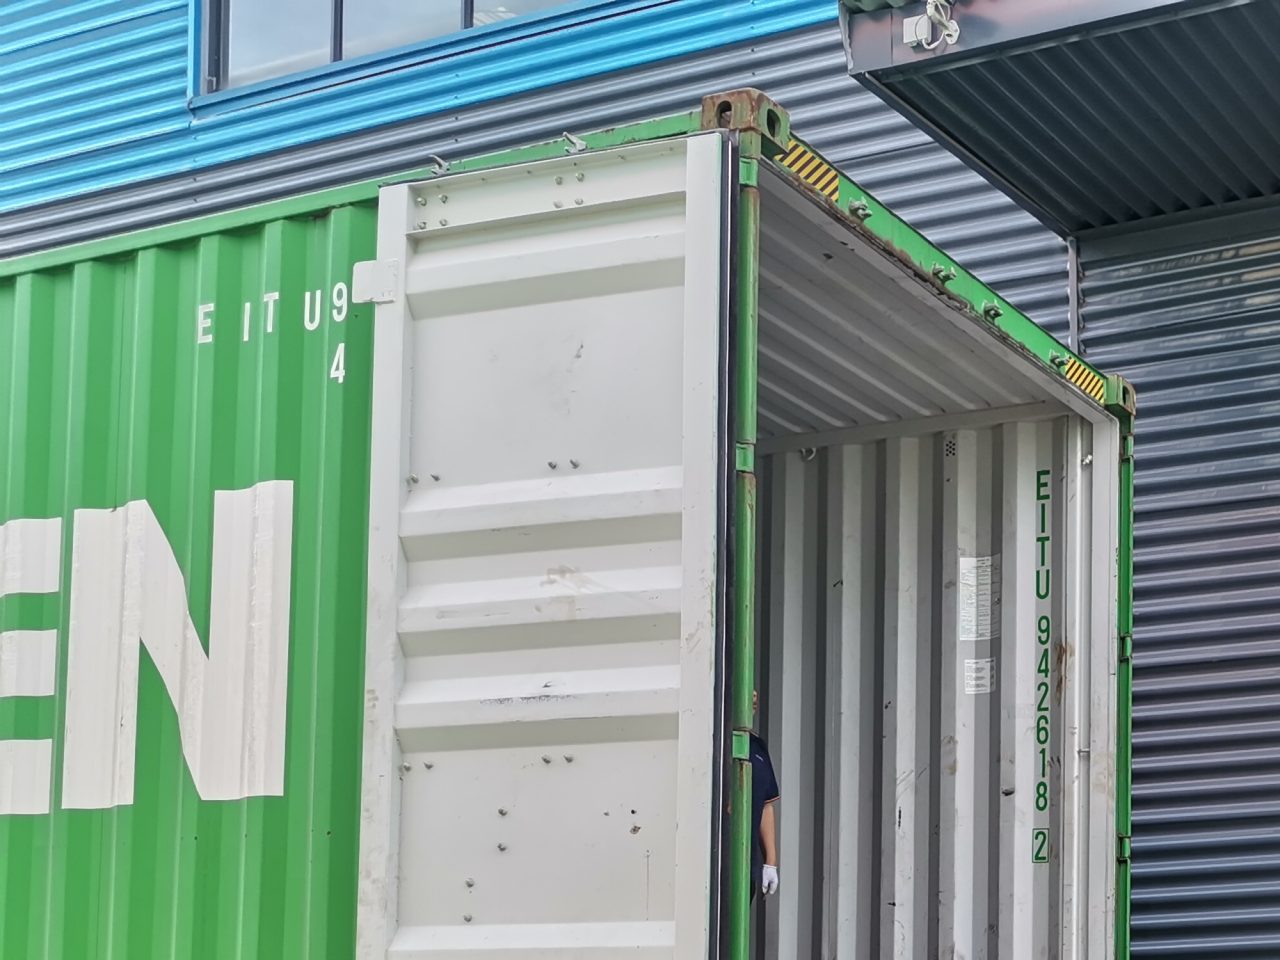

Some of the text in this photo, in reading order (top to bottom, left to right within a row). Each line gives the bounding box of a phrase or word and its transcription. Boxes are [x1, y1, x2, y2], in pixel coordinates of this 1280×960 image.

[329, 343, 346, 384] 4
[1035, 470, 1051, 600] EITU
[1035, 615, 1051, 812] 942618
